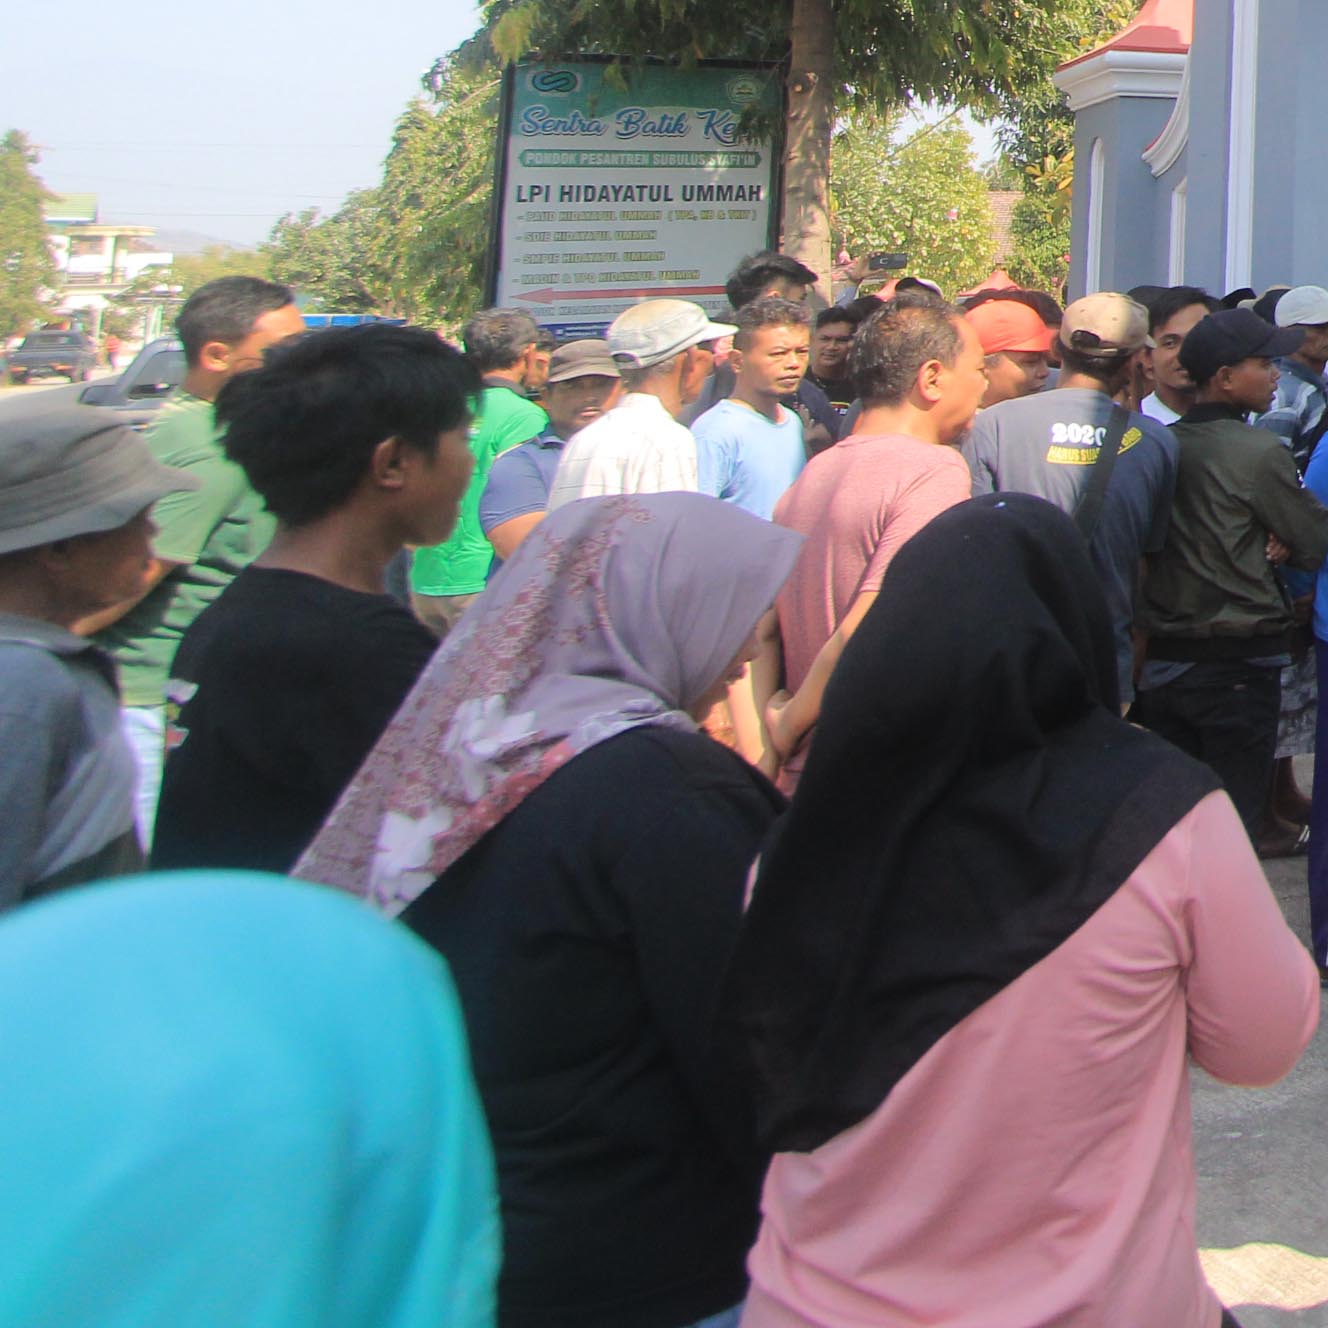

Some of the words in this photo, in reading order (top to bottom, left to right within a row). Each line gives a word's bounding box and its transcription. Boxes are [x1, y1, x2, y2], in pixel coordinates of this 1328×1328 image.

[520, 104, 609, 137] Sentra
[614, 106, 690, 140] Batik
[515, 184, 551, 203] LPI
[559, 184, 674, 203] HIDAYATUL
[681, 183, 762, 203] UMMAH
